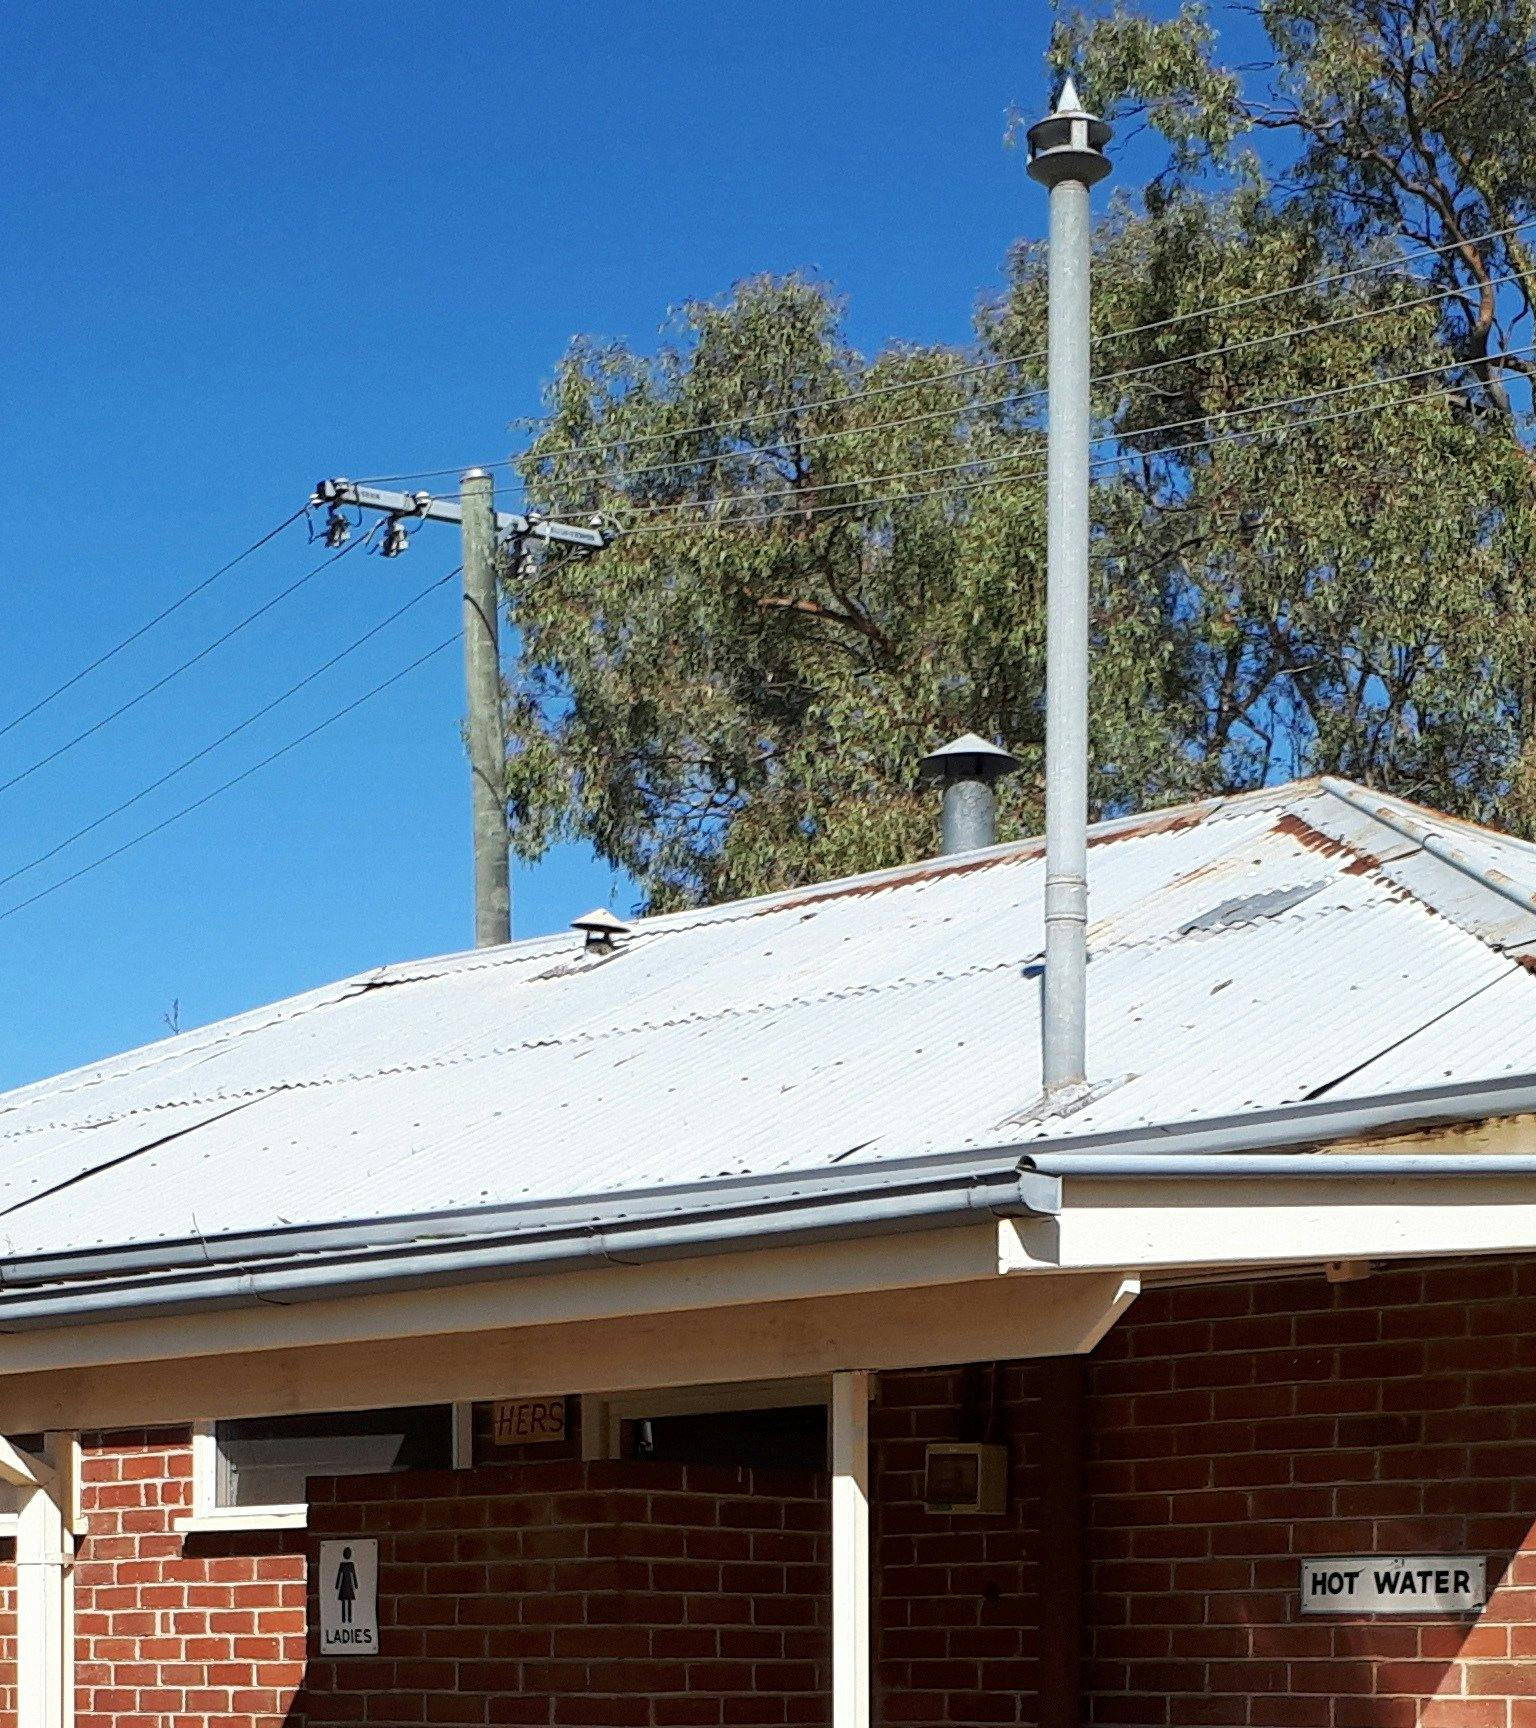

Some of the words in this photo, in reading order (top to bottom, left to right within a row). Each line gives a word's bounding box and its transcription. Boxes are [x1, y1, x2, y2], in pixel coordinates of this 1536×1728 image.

[498, 1401, 564, 1436] HERS
[1311, 1571, 1361, 1595] HOT
[1373, 1570, 1471, 1595] WATER
[325, 1628, 372, 1645] LADIES
